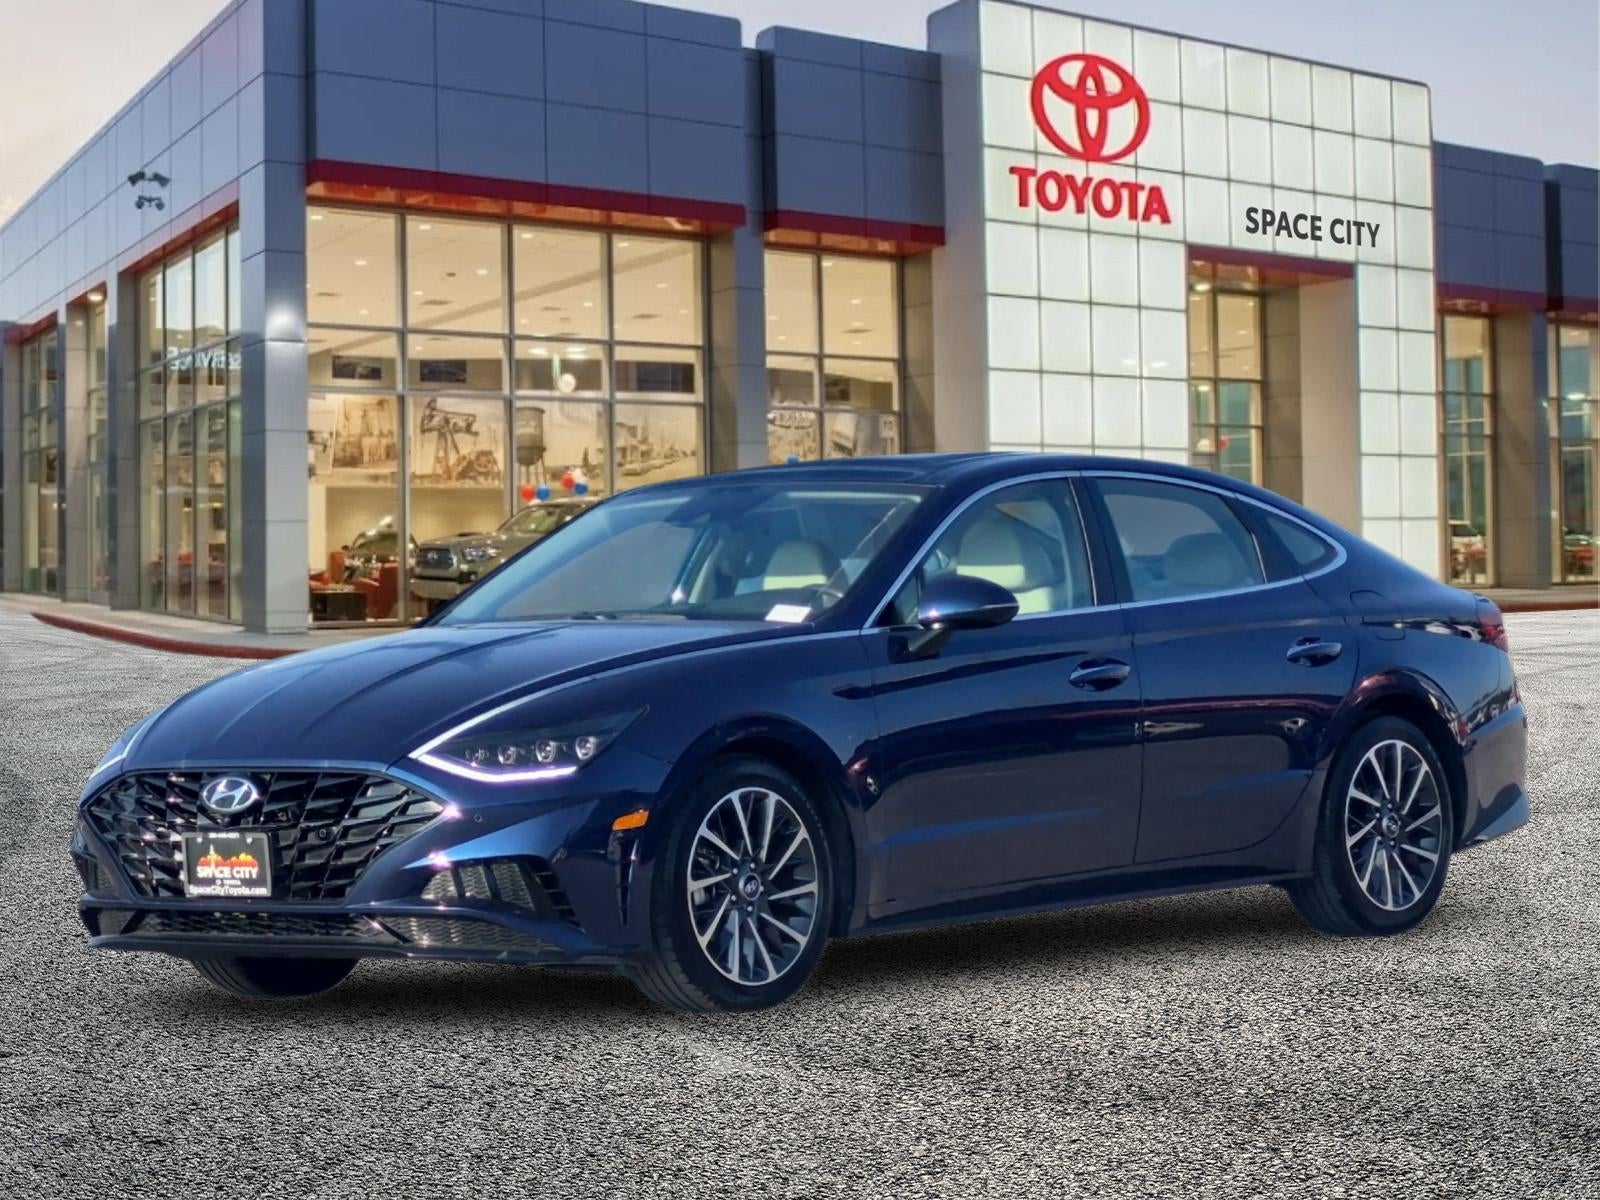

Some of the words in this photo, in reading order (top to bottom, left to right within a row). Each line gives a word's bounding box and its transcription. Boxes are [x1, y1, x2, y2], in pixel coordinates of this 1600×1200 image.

[1009, 166, 1171, 224] TOYOTA
[1245, 207, 1322, 241] SPACE
[1329, 218, 1380, 247] CITY
[197, 866, 231, 878] SPACE
[233, 866, 258, 878] CITY
[189, 885, 267, 896] SpaceCityToyota.com
